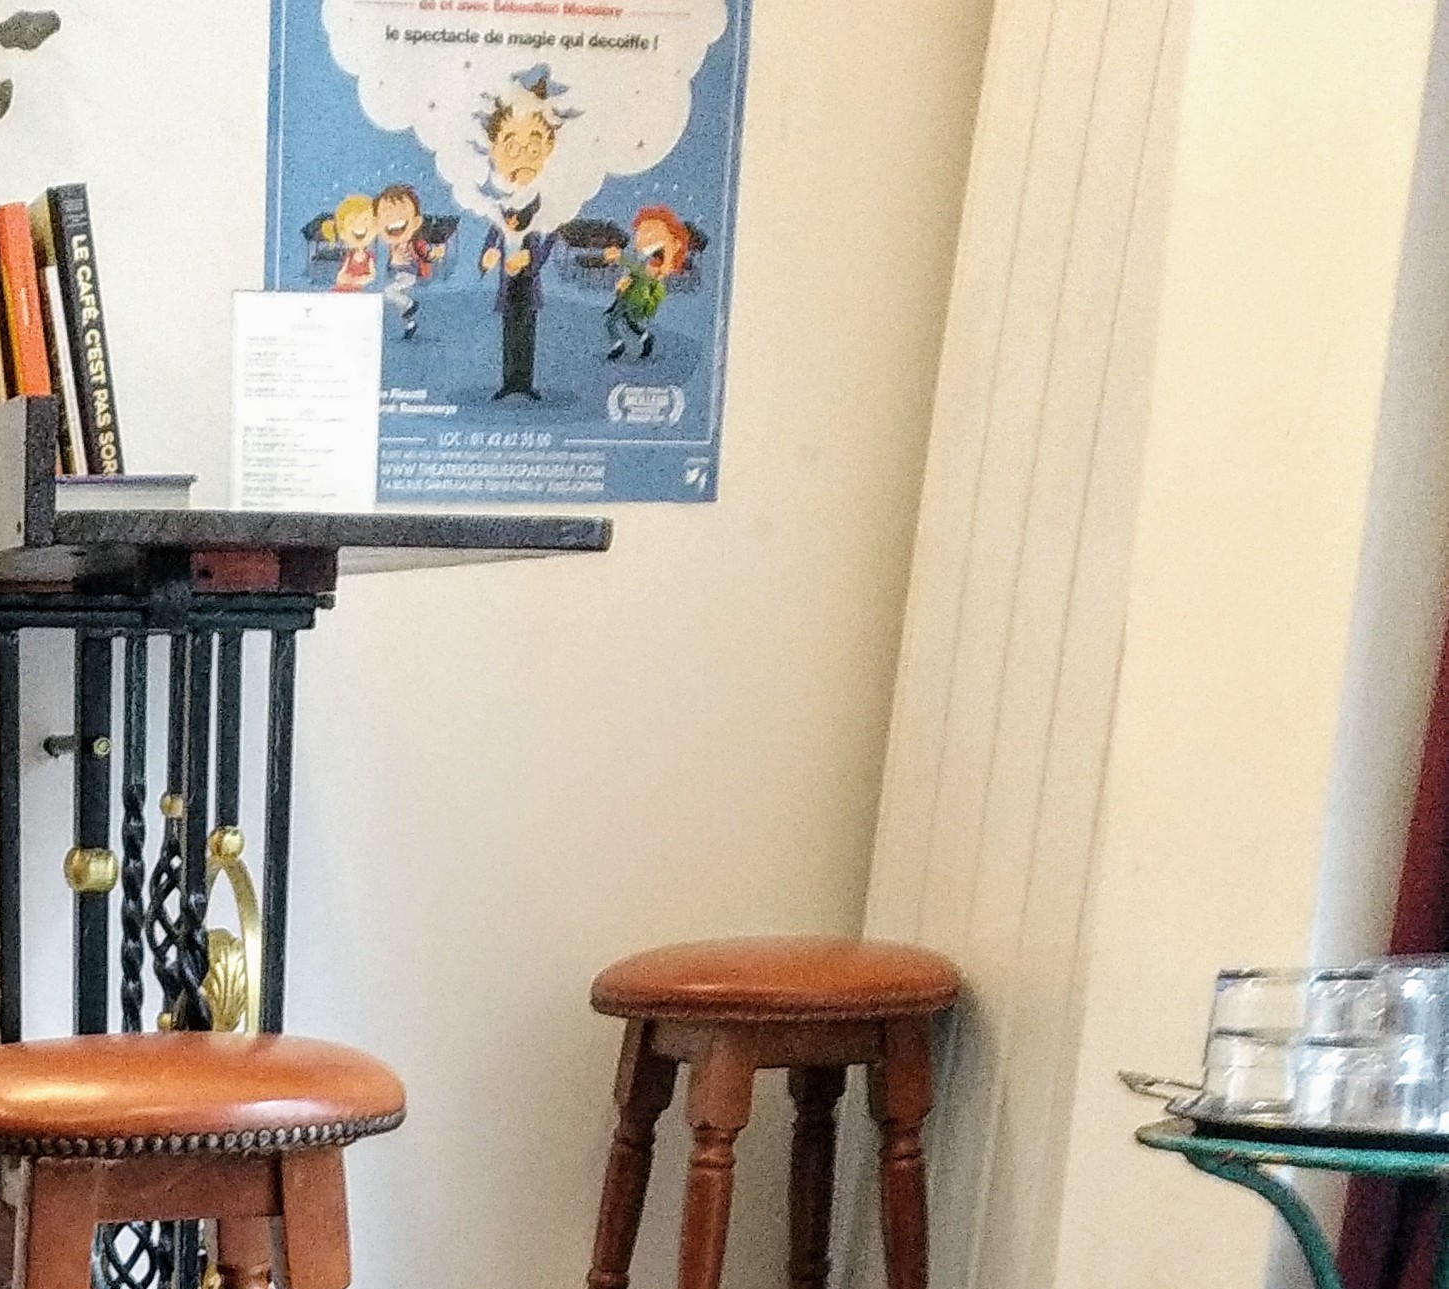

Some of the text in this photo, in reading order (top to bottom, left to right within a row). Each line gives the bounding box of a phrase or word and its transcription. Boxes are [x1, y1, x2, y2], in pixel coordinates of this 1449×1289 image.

[385, 25, 400, 41] le
[404, 28, 480, 45] spectacle
[483, 29, 504, 44] de
[507, 30, 557, 48] magie
[560, 32, 584, 50] qui
[71, 233, 90, 261] LE
[85, 328, 107, 385] C'EST
[92, 388, 112, 429] PAS
[99, 430, 119, 476] SOR
